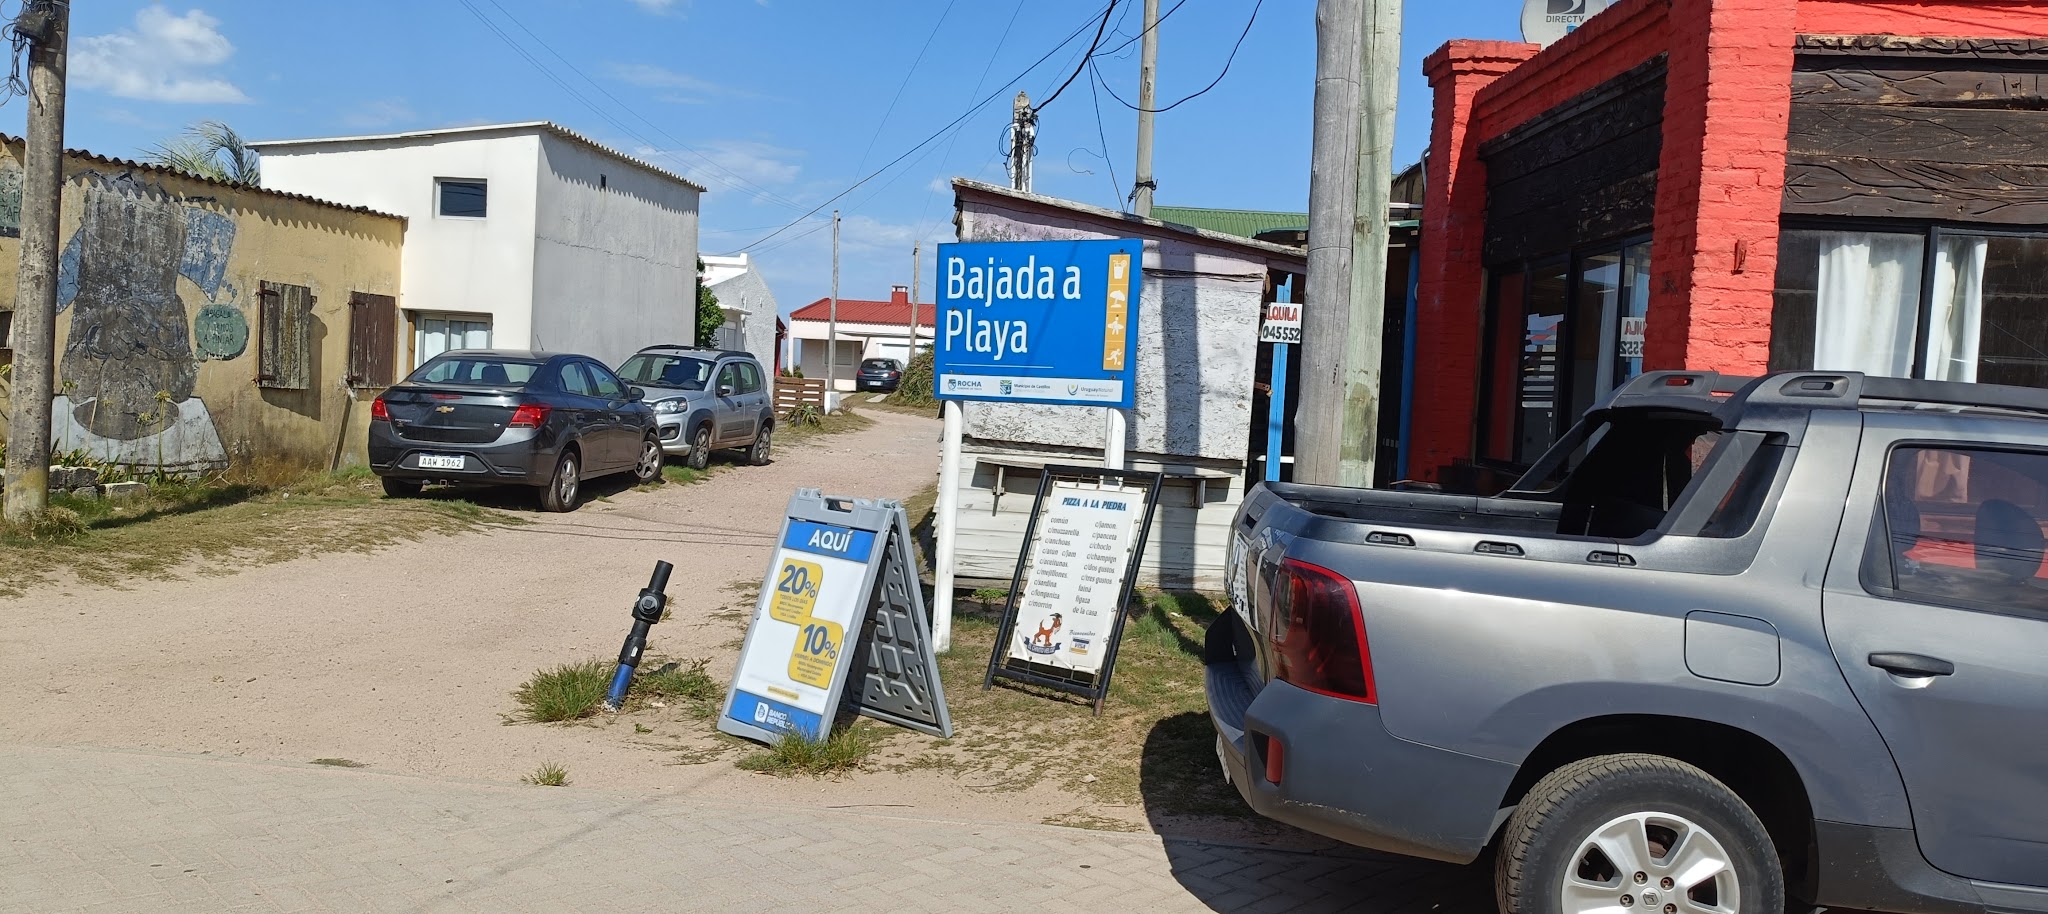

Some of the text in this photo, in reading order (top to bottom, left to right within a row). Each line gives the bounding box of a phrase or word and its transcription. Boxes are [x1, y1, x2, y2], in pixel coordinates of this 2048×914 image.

[1546, 15, 1584, 23] DIRECTV
[947, 255, 1081, 307] Bajada a
[1266, 306, 1297, 321] LQUILA
[945, 308, 1028, 361] Playa
[1263, 325, 1300, 341] 045552
[441, 458, 462, 467] 1962
[1062, 497, 1127, 511] PIZZA A LA PIEDRA
[808, 529, 853, 552] AQUÍ
[778, 564, 816, 599] 20%
[803, 624, 836, 660] 10%
[769, 709, 787, 721] BANCO
